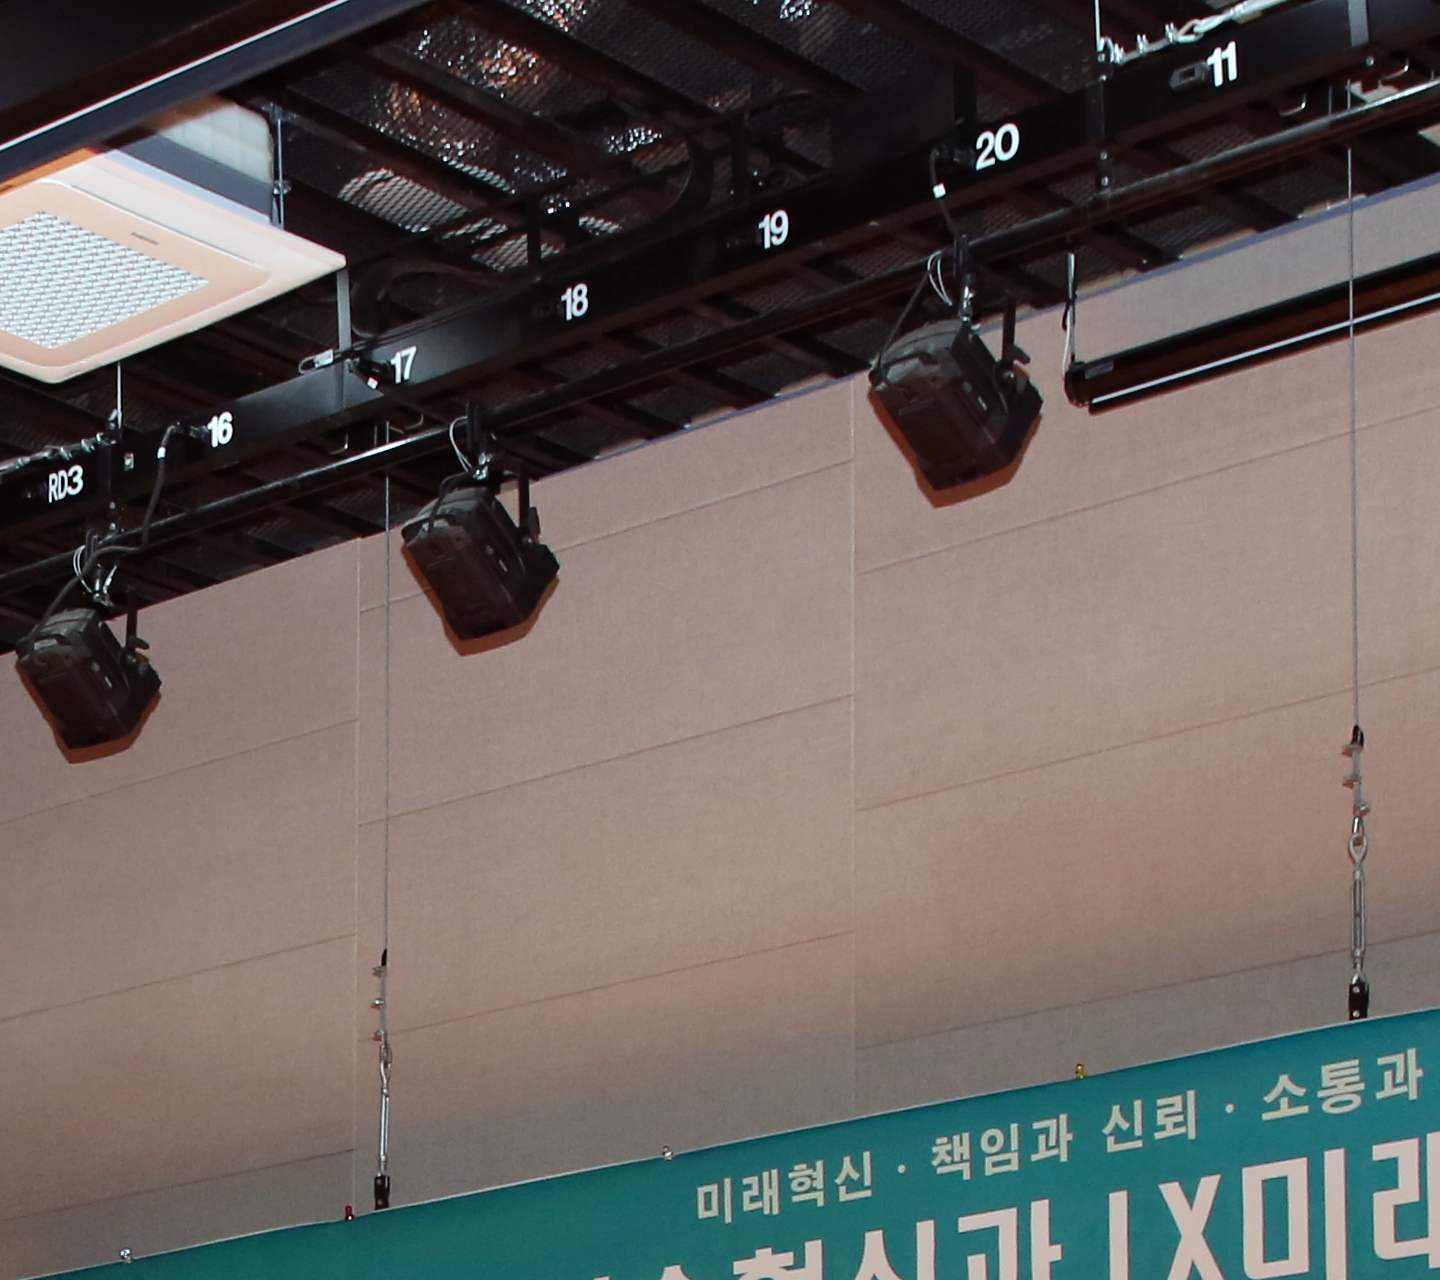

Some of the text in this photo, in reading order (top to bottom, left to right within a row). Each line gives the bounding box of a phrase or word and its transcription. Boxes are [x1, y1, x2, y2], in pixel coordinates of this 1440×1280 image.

[1207, 42, 1237, 86] 11
[976, 124, 1019, 170] 20
[759, 210, 788, 248] 19
[561, 284, 588, 320] 18
[391, 346, 416, 382] 17
[207, 412, 232, 447] 16
[49, 465, 83, 503] RD3
[698, 1151, 872, 1223] 미래혁신
[932, 1114, 1072, 1180] 책임과
[1102, 1090, 1195, 1152] 신뢰
[1262, 1048, 1423, 1120] 소통과
